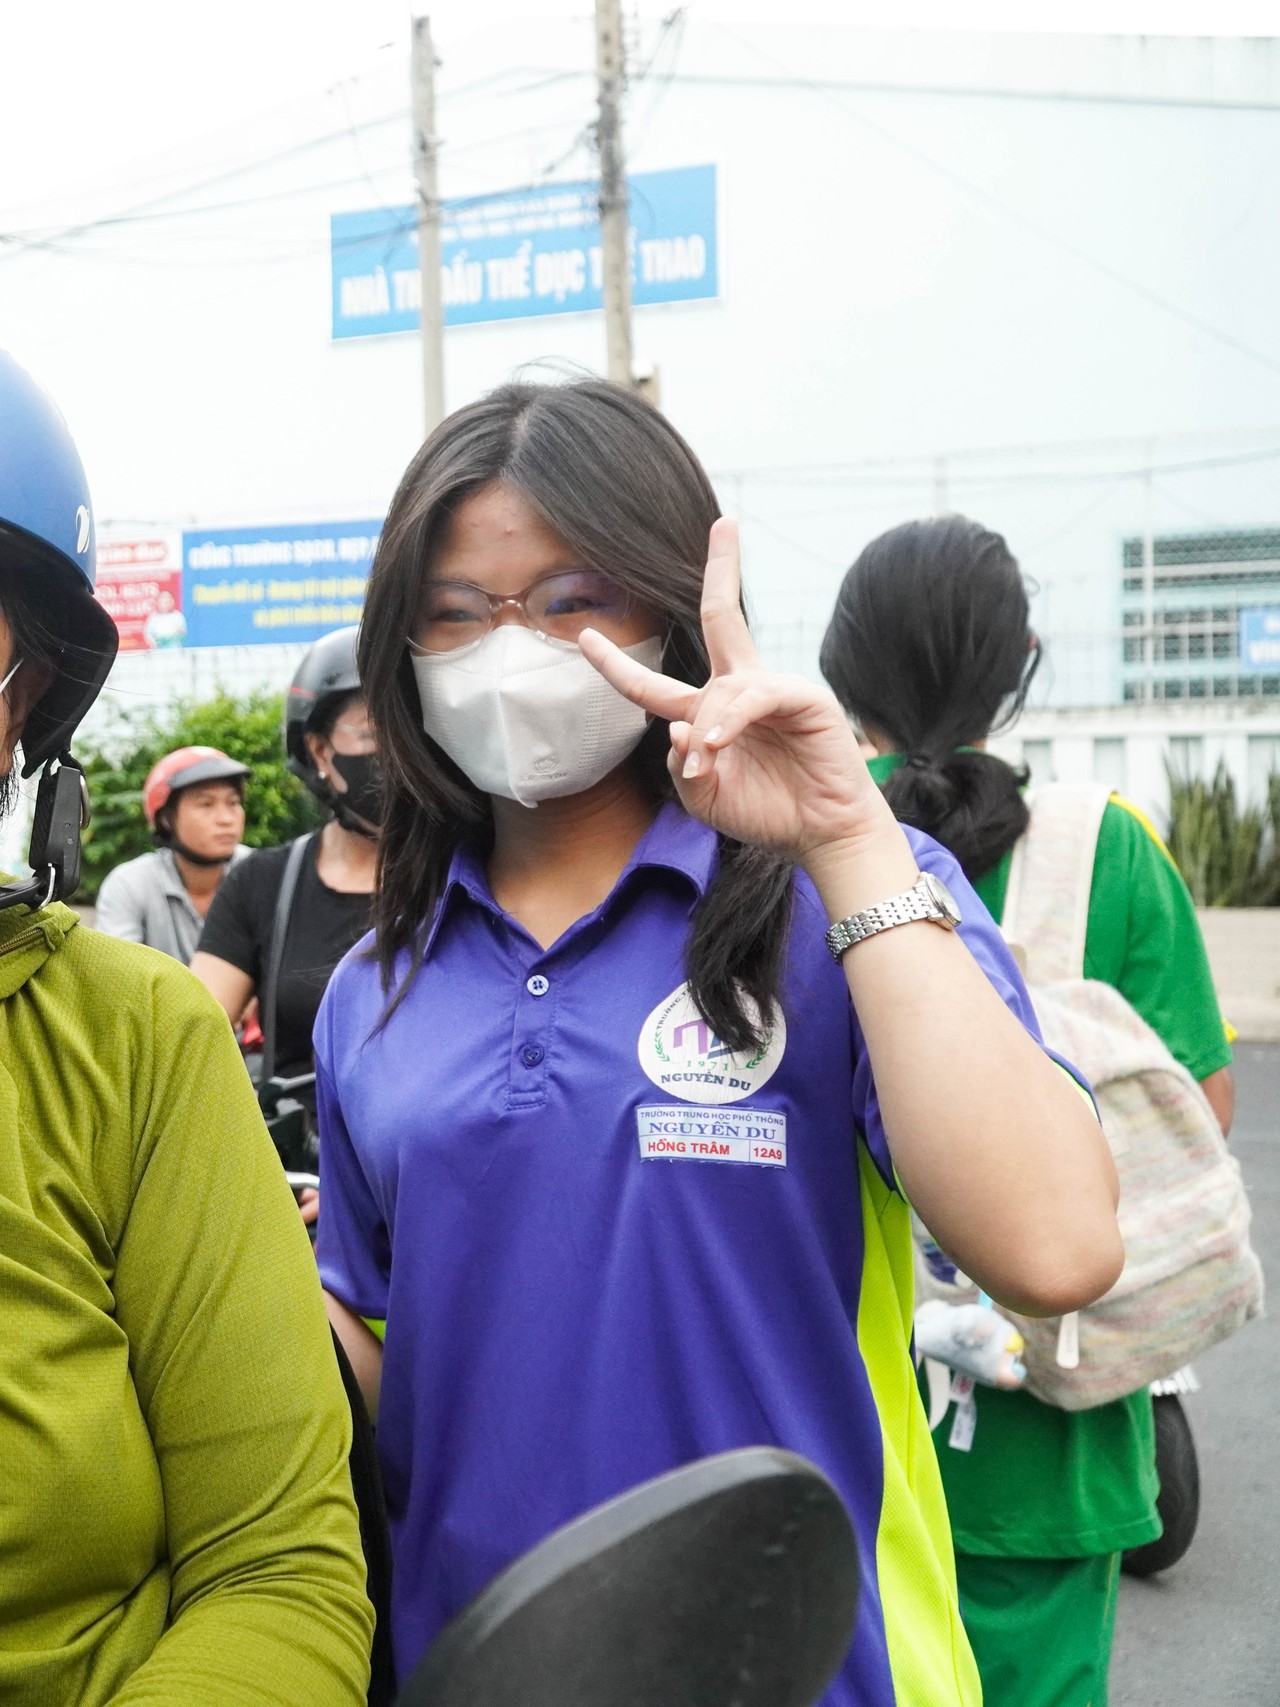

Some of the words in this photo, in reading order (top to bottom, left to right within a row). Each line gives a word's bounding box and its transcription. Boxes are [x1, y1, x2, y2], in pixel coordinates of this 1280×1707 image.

[340, 266, 390, 317] NHÀ
[641, 234, 706, 284] THAO
[728, 1078, 751, 1091] DU
[640, 1108, 676, 1118] TRƯỜNG
[677, 1110, 710, 1119] TRUNG
[711, 1113, 731, 1121] HỌC
[732, 1113, 752, 1122] PHỔ
[755, 1115, 784, 1126] THÔNG
[649, 1121, 740, 1137] NGUYỄN
[746, 1126, 776, 1140] DU
[647, 1138, 686, 1153] HỒNG
[690, 1141, 730, 1155] TRÂM
[753, 1147, 783, 1160] 12A9
